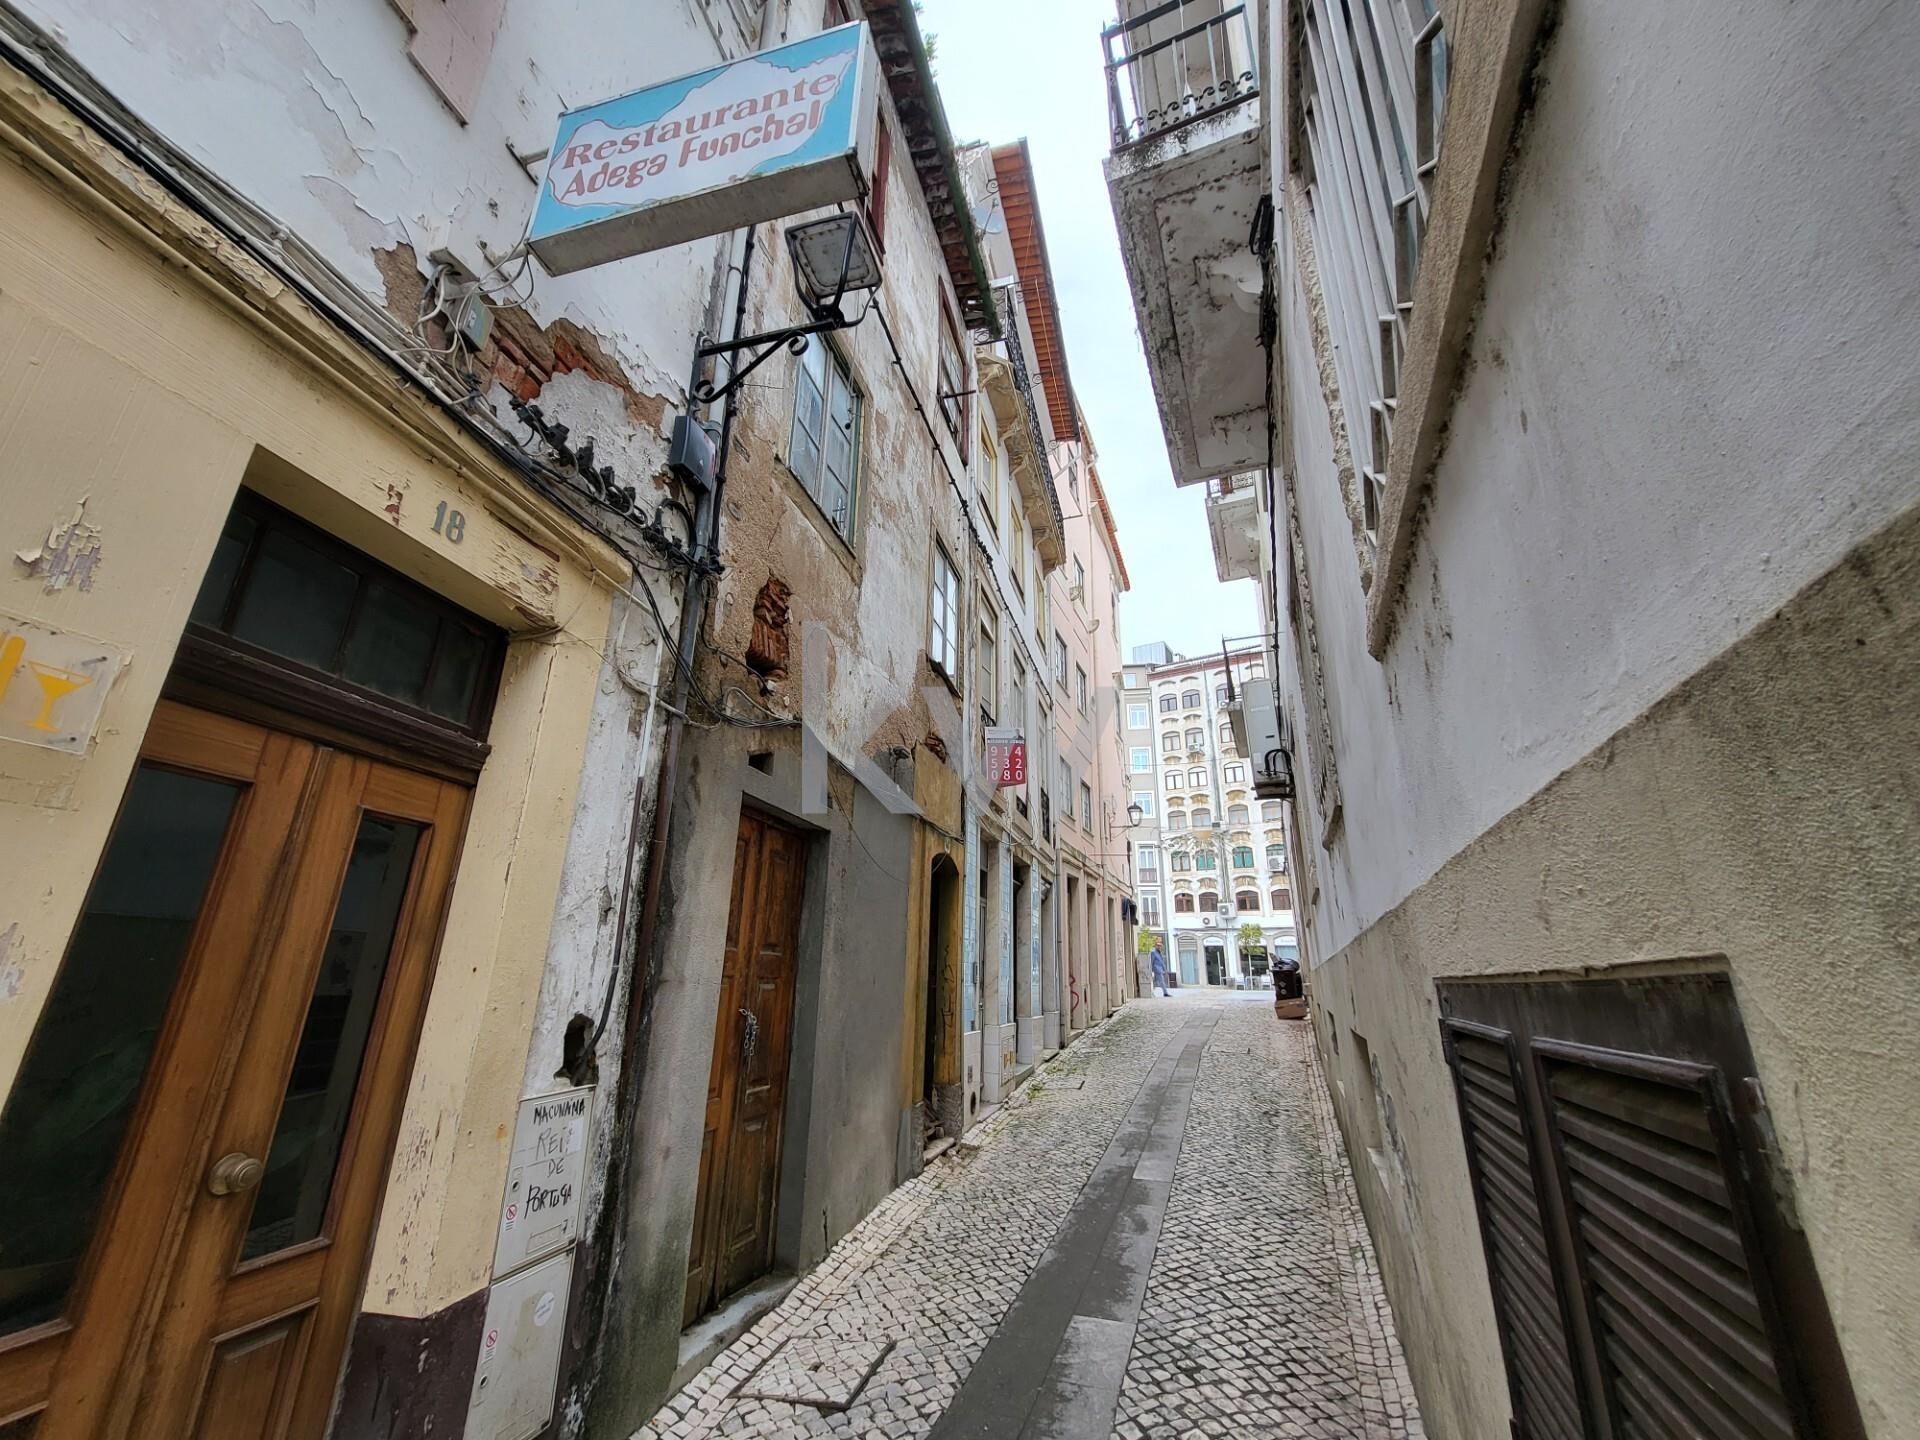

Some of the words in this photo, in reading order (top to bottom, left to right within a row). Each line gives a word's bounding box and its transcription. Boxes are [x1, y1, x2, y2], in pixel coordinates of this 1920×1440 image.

[558, 154, 668, 201] Adega
[677, 100, 822, 168] Funchal
[562, 72, 837, 169] Restaurante
[431, 500, 466, 545] 18
[547, 1157, 565, 1178] DE
